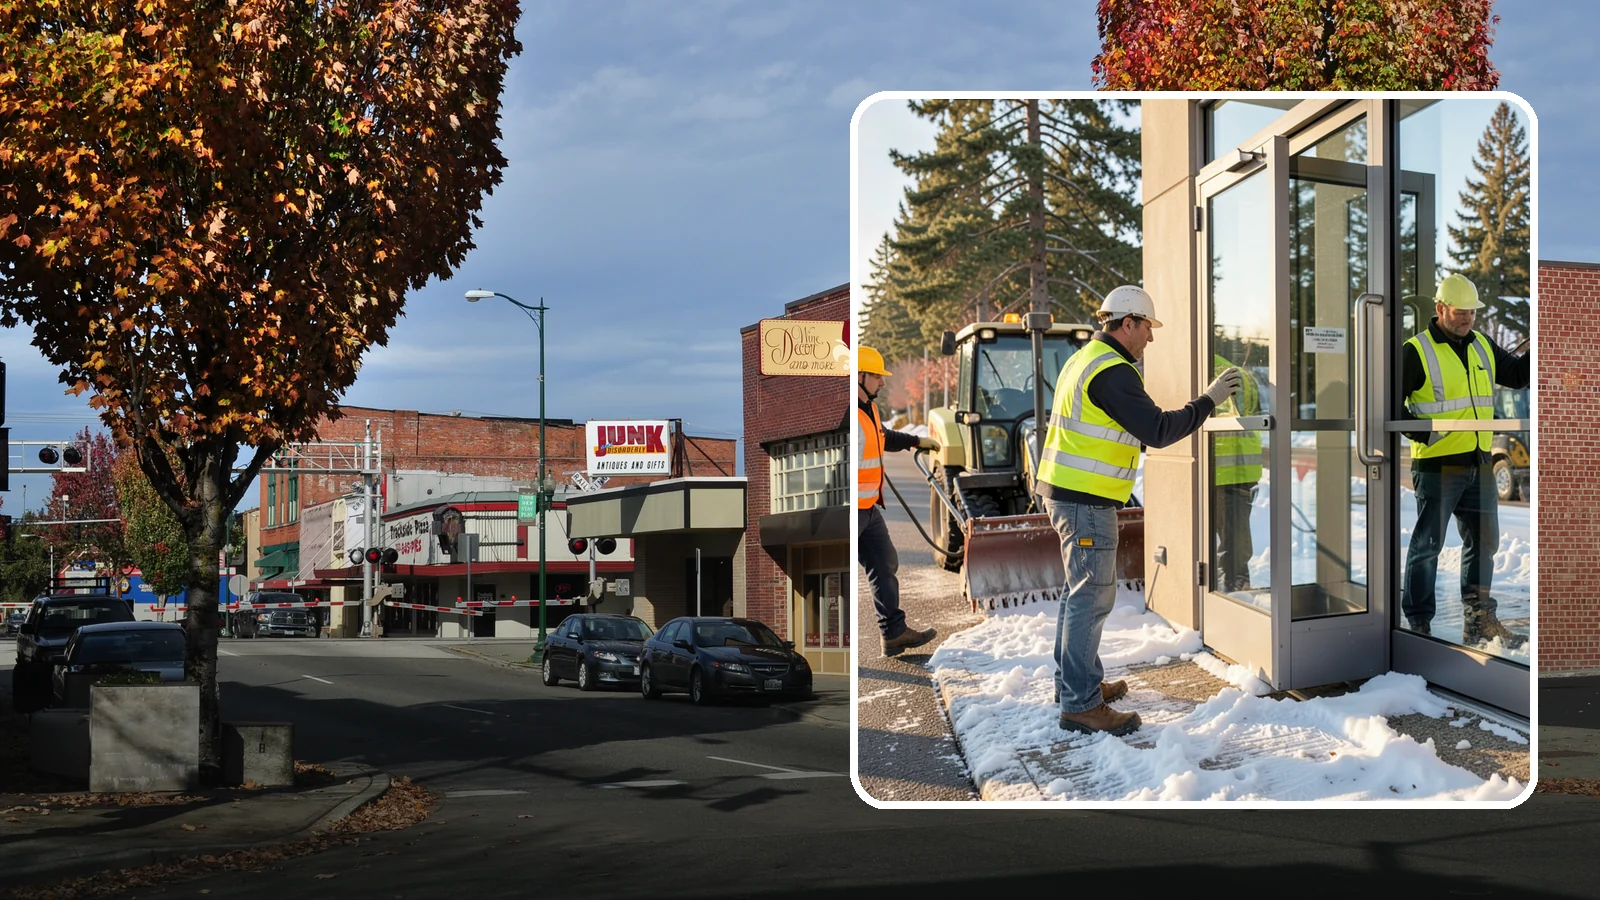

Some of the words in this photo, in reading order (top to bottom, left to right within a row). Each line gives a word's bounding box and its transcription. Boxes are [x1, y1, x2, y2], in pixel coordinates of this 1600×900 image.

[596, 425, 665, 457] JUNK
[607, 445, 646, 454] DISORDERLY
[597, 461, 628, 470] ANTIQUES
[631, 461, 644, 470] AND
[647, 460, 665, 469] GIFTS
